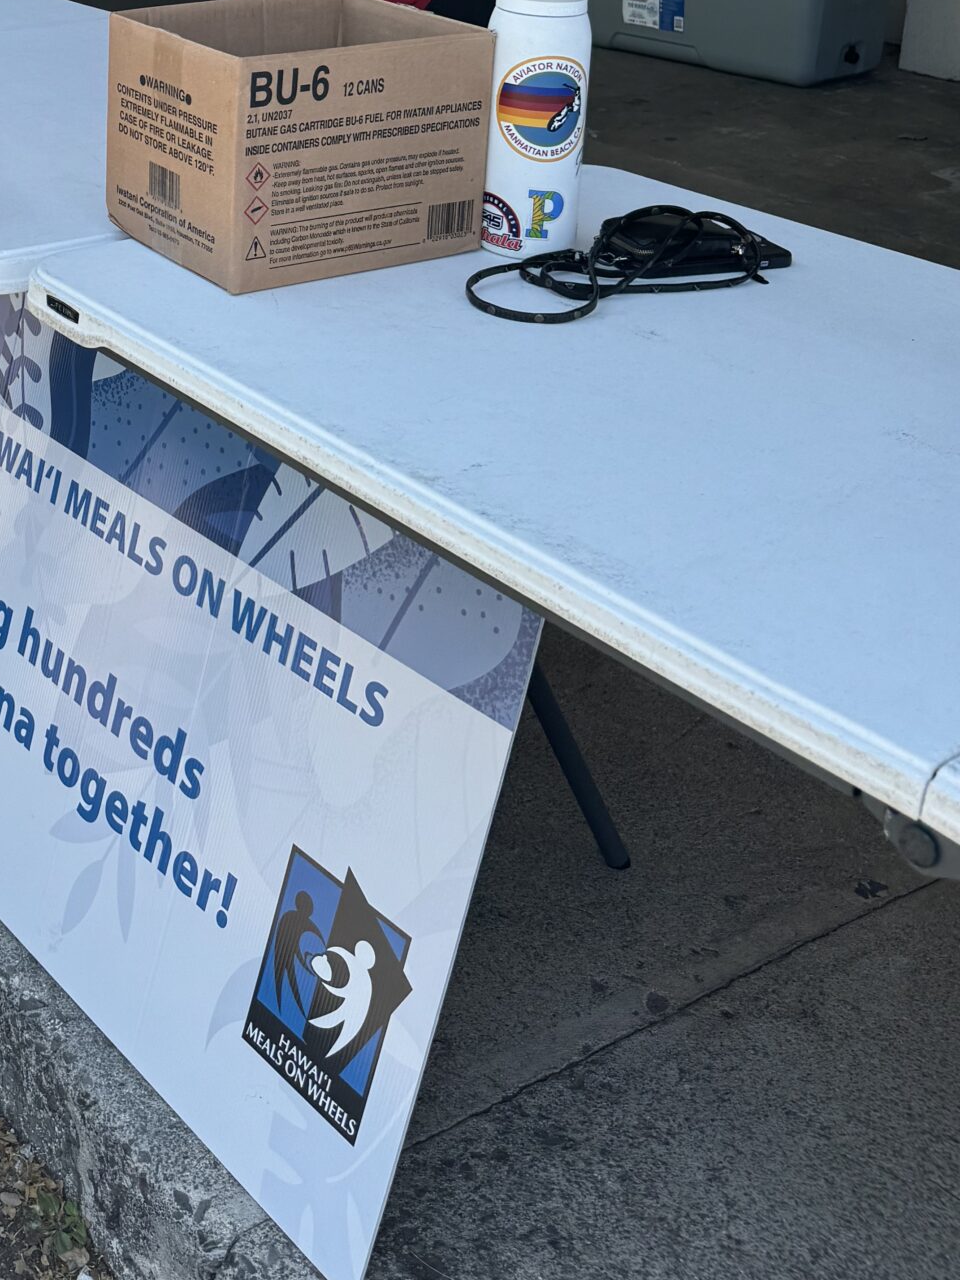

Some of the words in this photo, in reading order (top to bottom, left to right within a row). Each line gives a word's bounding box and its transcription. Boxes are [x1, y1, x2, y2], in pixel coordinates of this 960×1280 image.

[249, 66, 330, 106] BU-6
[343, 82, 354, 96] 12
[356, 79, 384, 94] CANS
[512, 62, 553, 83] AVIATOR
[556, 62, 583, 82] NATION
[117, 82, 151, 106] CONTENTS
[153, 98, 176, 116] UNDER
[178, 108, 217, 134] PRESSURE
[121, 97, 159, 122] EXTREMELY
[160, 115, 203, 142] FLAMMABLE
[205, 134, 212, 146] IN
[246, 126, 277, 138] BUTANE
[280, 123, 296, 134] GAS
[298, 118, 343, 132] CARTRIDGE
[345, 115, 363, 126] BU-6
[364, 113, 384, 123] FUEL
[385, 110, 401, 121] FOR
[403, 106, 433, 118] IWATANI
[435, 100, 481, 114] APPLIANCES
[261, 110, 292, 122] UN2037
[118, 122, 128, 135] DO
[129, 127, 143, 142] NOT
[144, 134, 167, 153] STORE
[169, 146, 192, 165] ABOVE
[119, 110, 137, 126] CASE
[138, 118, 147, 130] OF
[149, 123, 164, 138] FIRE
[166, 131, 175, 143] OR
[177, 136, 213, 161] LEAKAGE.
[245, 144, 269, 156] INSIDE
[271, 138, 319, 152] CONTAINERS
[321, 133, 351, 146] COMPLY
[352, 131, 370, 142] WITH
[372, 124, 419, 139] PRESCRIBED
[420, 116, 480, 133] SPECIFICATIONS
[504, 124, 548, 157] MANHATTAN
[116, 183, 137, 204] Iwatani
[139, 195, 176, 225] Corporation
[178, 216, 185, 229] of
[187, 220, 215, 245] America
[525, 189, 564, 238] P
[64, 479, 167, 576] MEALS
[172, 555, 226, 619] ON
[231, 588, 389, 727] WHEELS
[17, 606, 205, 800] hundreds
[43, 723, 238, 929] together!
[246, 1021, 284, 1067] MEALS
[284, 1051, 308, 1089] ON
[307, 1079, 357, 1136] WHEELS
